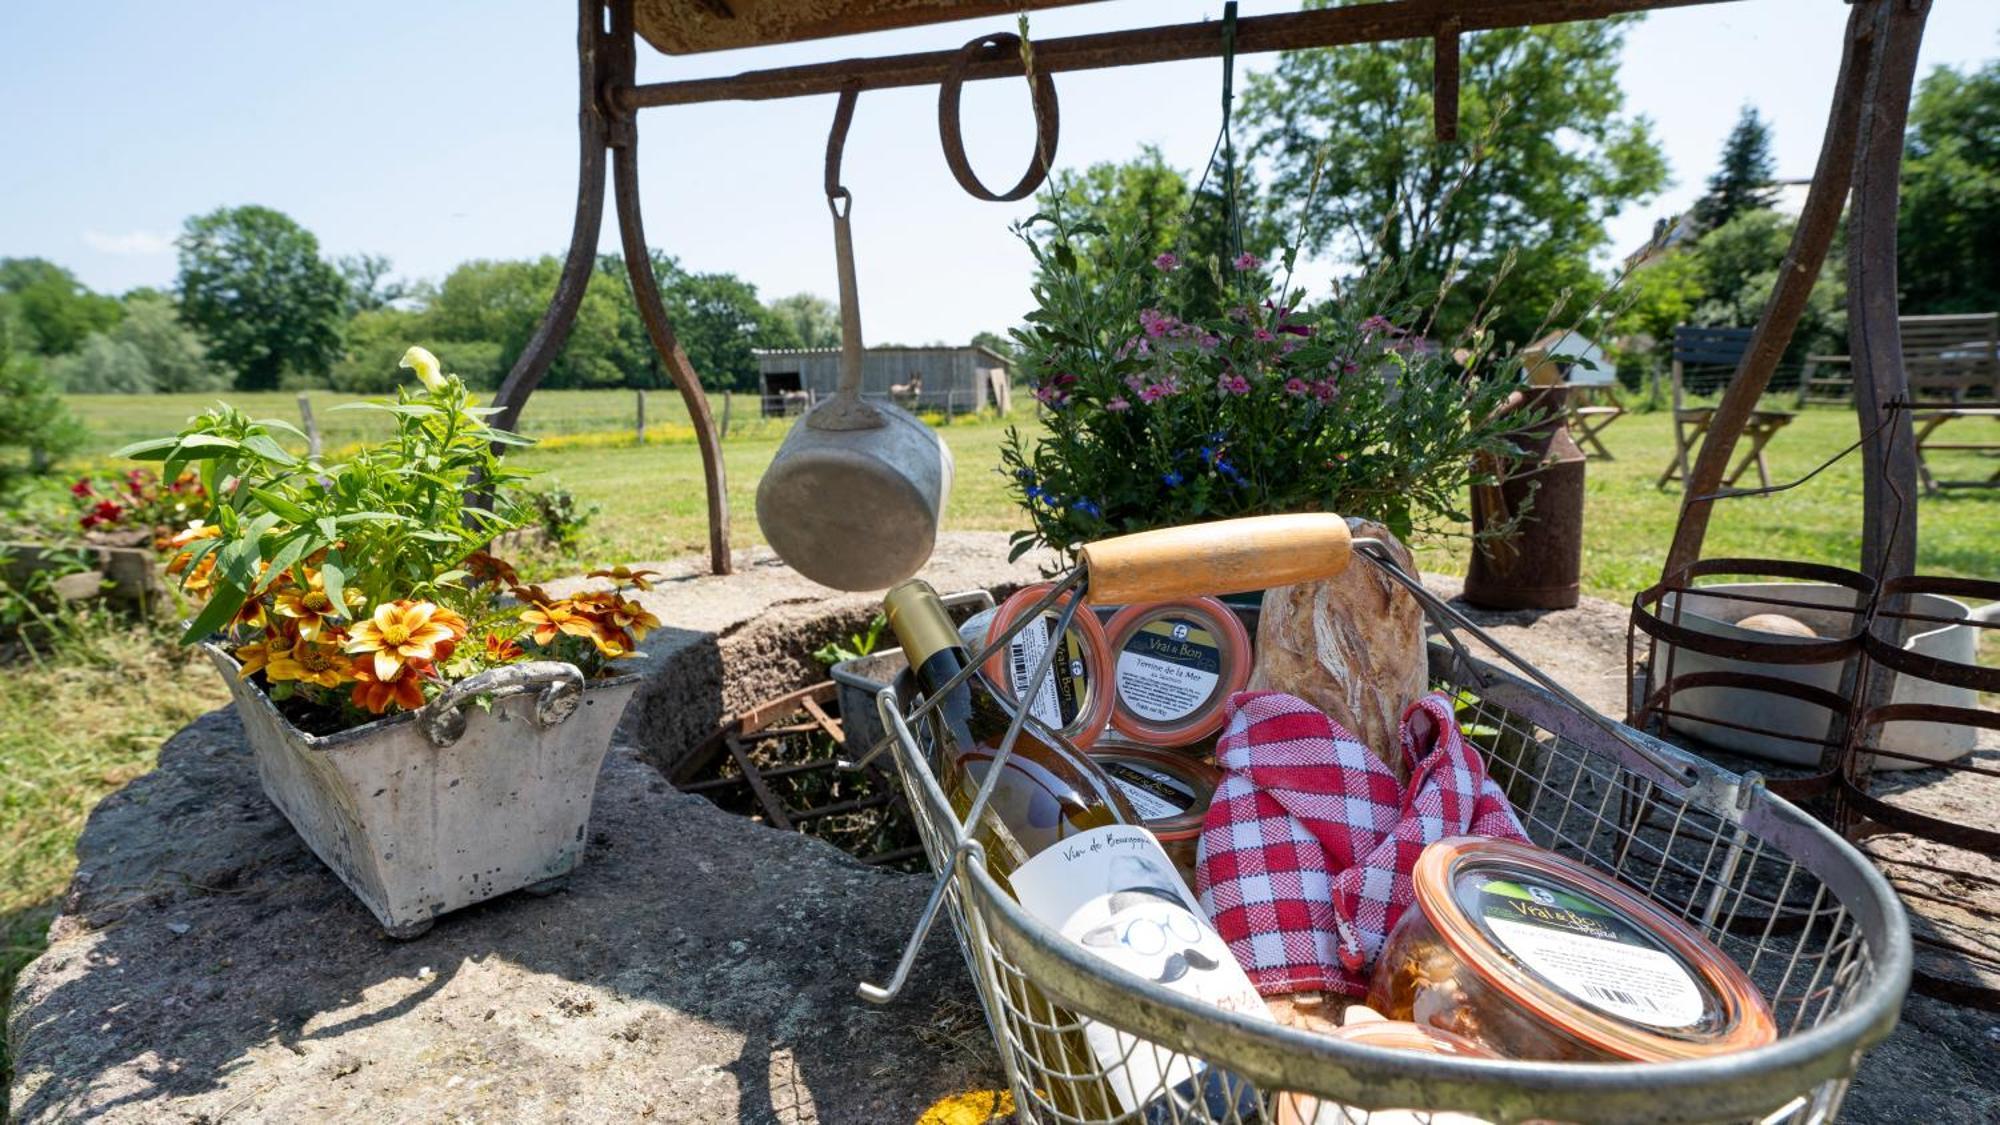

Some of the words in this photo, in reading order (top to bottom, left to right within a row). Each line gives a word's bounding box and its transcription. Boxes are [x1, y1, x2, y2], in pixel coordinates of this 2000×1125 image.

[1149, 637, 1170, 653] Vrai
[1179, 642, 1203, 658] Bon
[1164, 664, 1175, 674] de
[1062, 676, 1072, 701] Bon
[1063, 845, 1085, 862] Vin
[1090, 837, 1102, 852] de
[1508, 899, 1551, 920] Vrai
[1564, 908, 1610, 931] Bon
